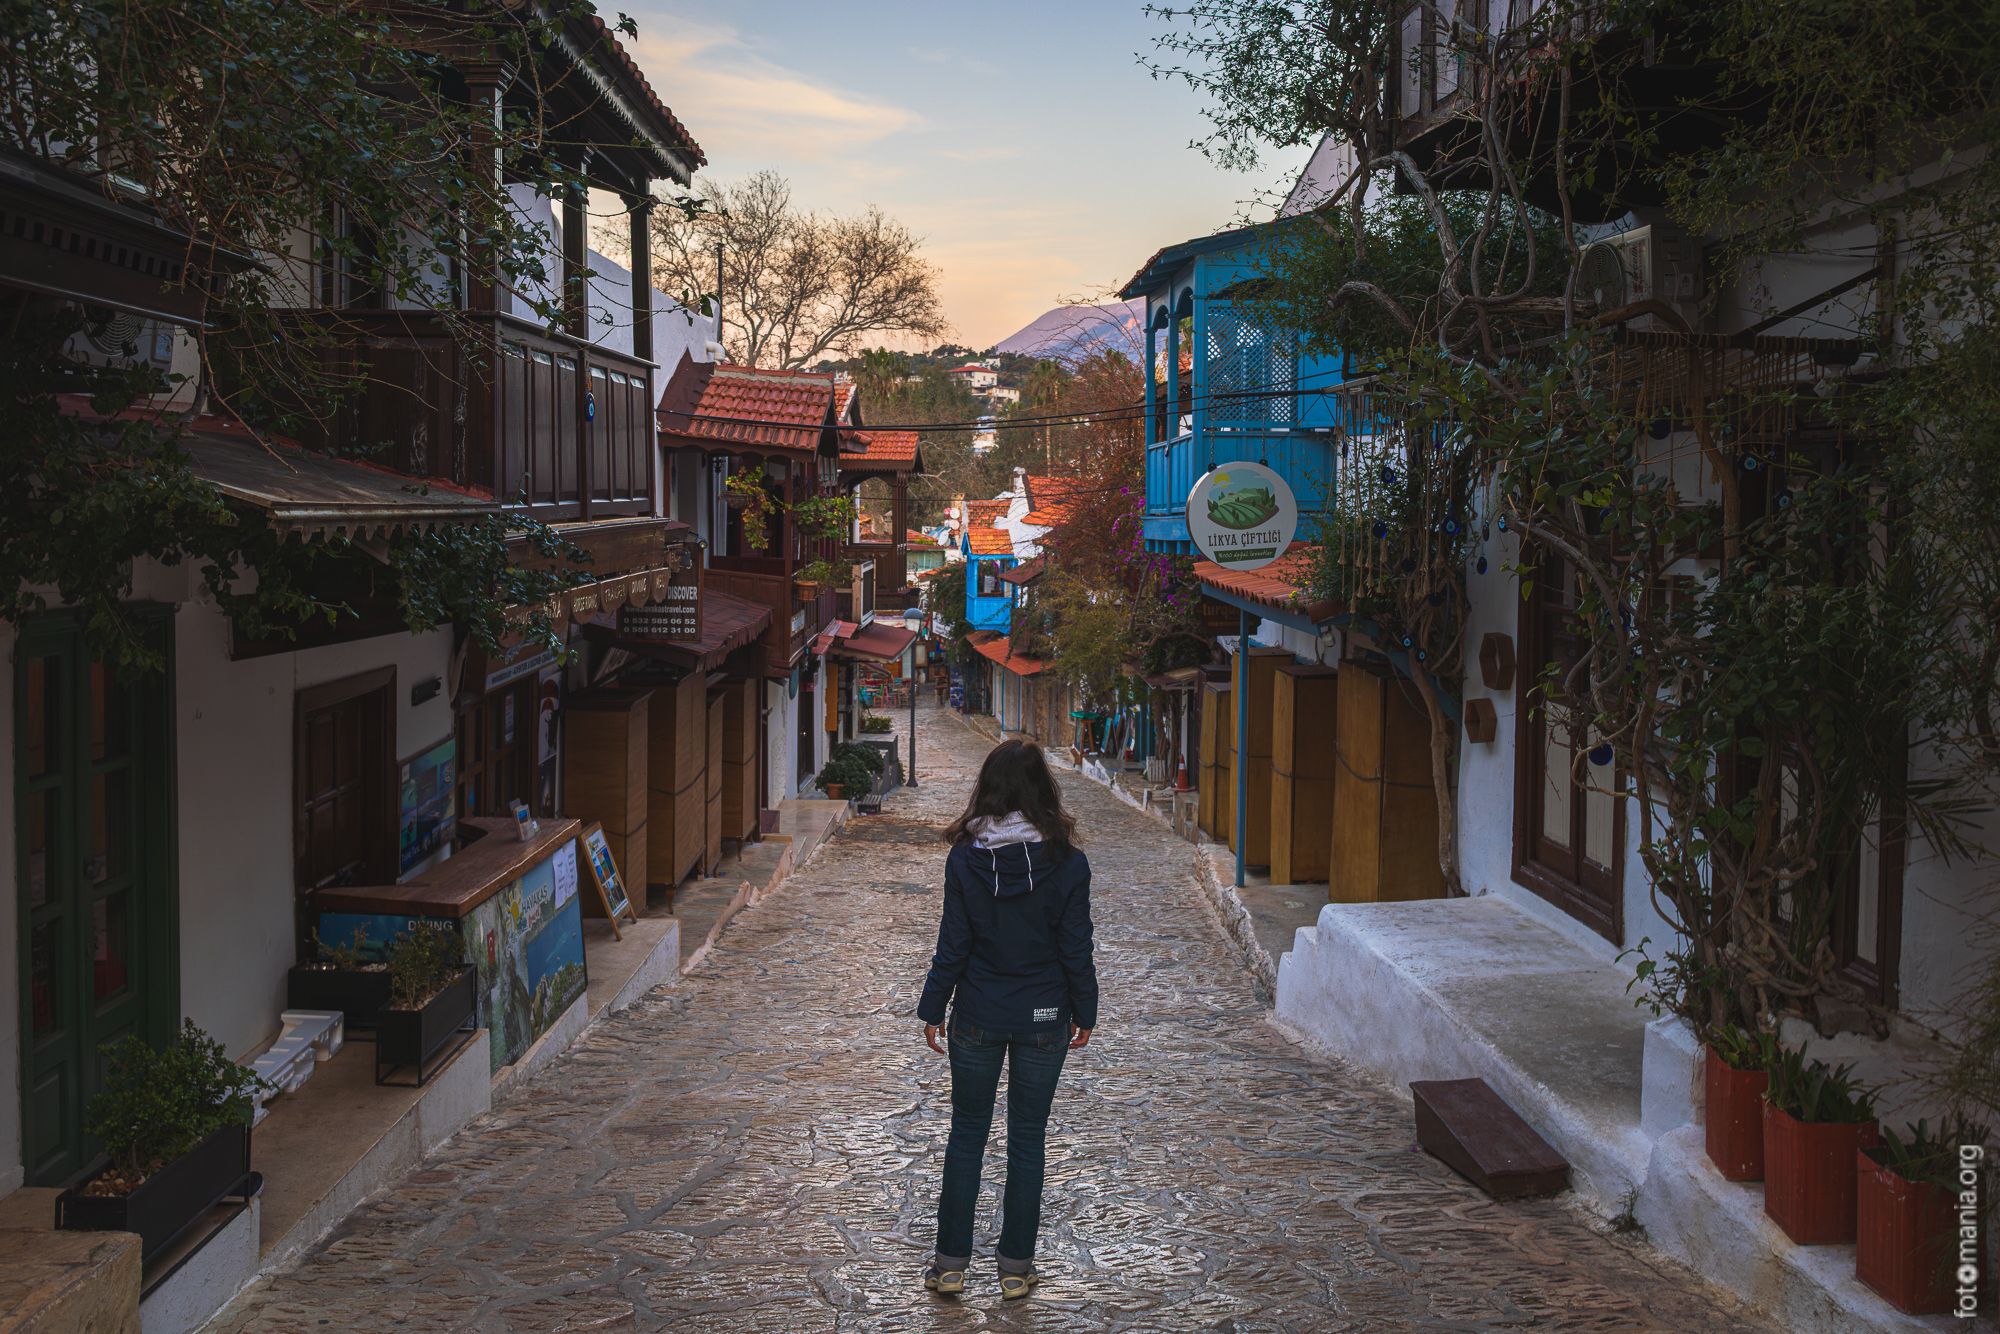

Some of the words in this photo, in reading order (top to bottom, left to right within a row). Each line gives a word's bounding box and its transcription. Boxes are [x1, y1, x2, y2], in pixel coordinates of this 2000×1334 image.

[1208, 533, 1238, 547] LİKYA
[1241, 530, 1281, 548] ÇİFTLİĞİ
[667, 585, 698, 601] DISCOVER
